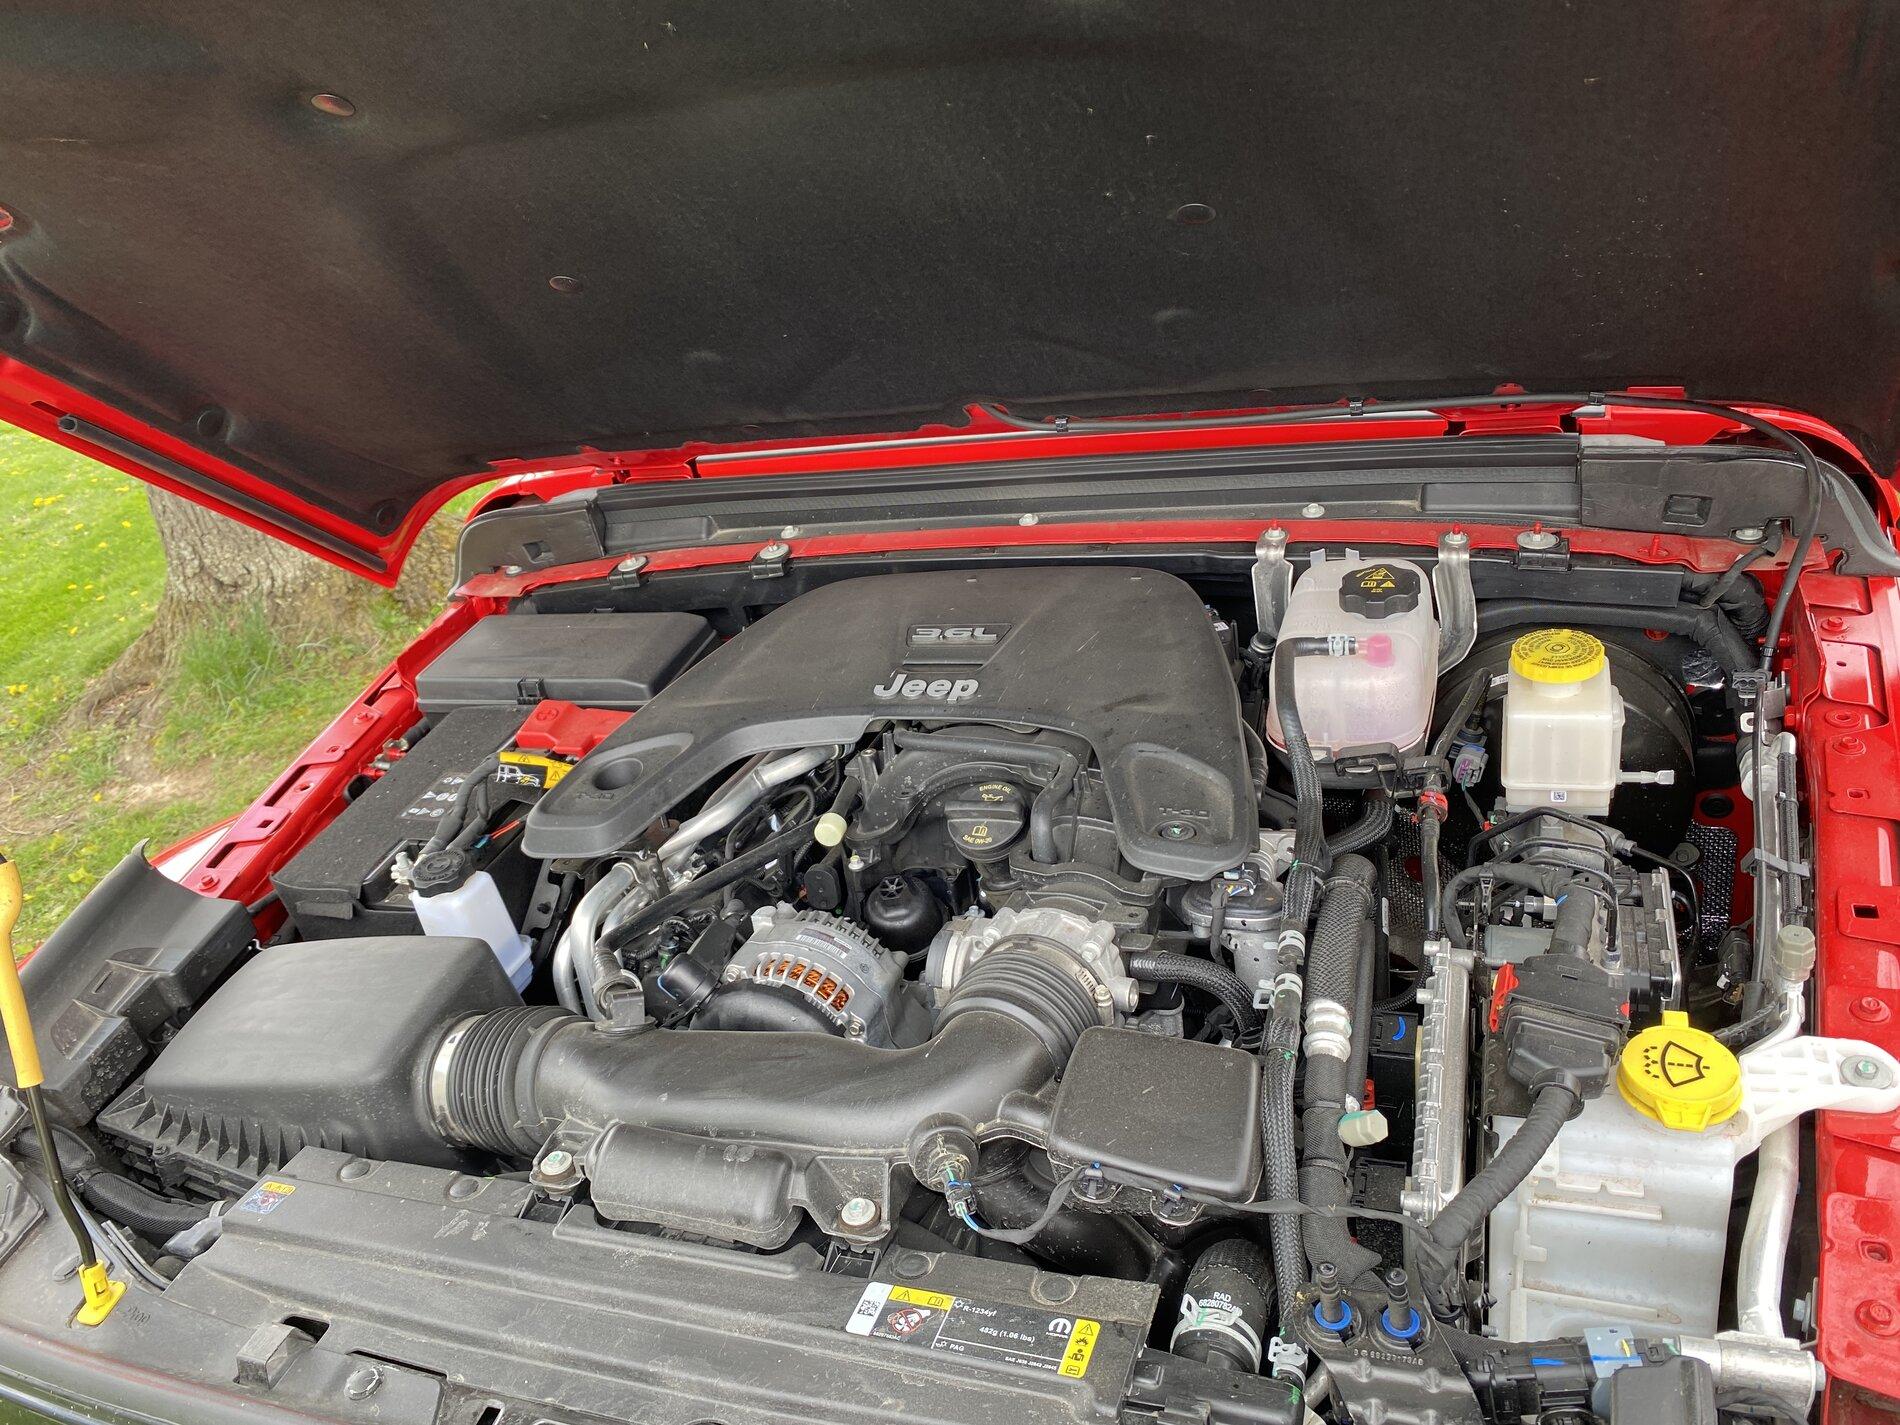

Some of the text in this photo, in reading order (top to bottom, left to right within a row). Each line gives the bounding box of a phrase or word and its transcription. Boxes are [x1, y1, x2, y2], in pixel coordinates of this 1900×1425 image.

[911, 626, 997, 642] 3.6L
[873, 673, 980, 704] Jeep
[978, 783, 1012, 794] ENGINE OIL
[962, 834, 975, 844] SAE
[1213, 1291, 1232, 1303] RAD
[962, 1305, 998, 1317] R-1234yf
[999, 1329, 1019, 1339] (1.06
[1020, 1333, 1036, 1343] lbs)
[949, 1343, 965, 1352] PAG
